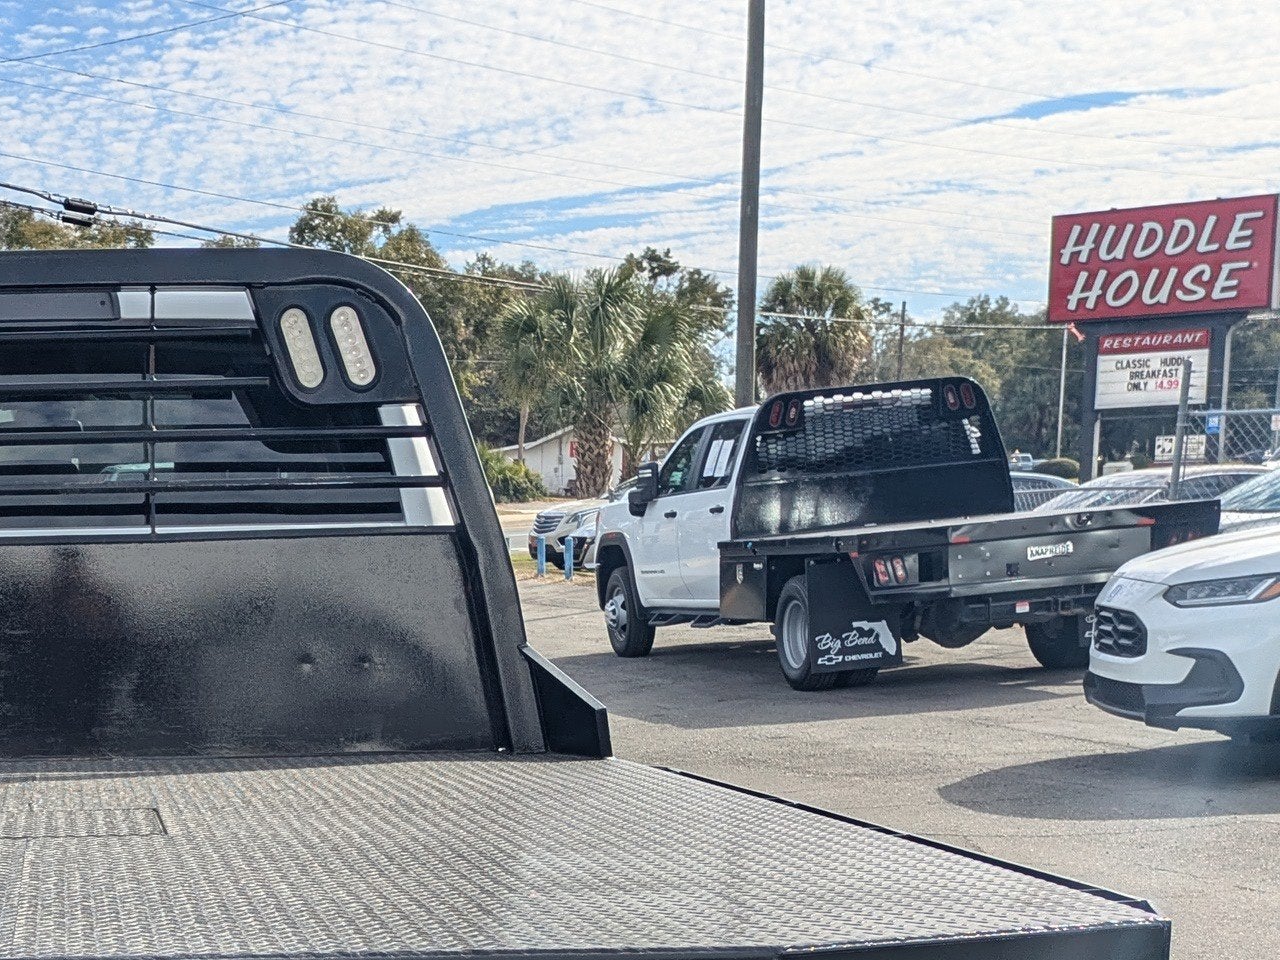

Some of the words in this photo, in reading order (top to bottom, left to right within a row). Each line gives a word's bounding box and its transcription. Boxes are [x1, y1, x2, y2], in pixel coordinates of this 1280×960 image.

[1060, 211, 1264, 265] HUDDLE
[1067, 262, 1249, 311] HOUSE
[1103, 333, 1204, 349] RESTAURANT
[1115, 358, 1151, 370] CLASSIC
[1129, 368, 1179, 380] BREAKFAST
[1126, 381, 1148, 392] ONLY
[815, 632, 841, 654] Big
[842, 630, 878, 647] Bend
[844, 651, 883, 662] CHEVROLET
